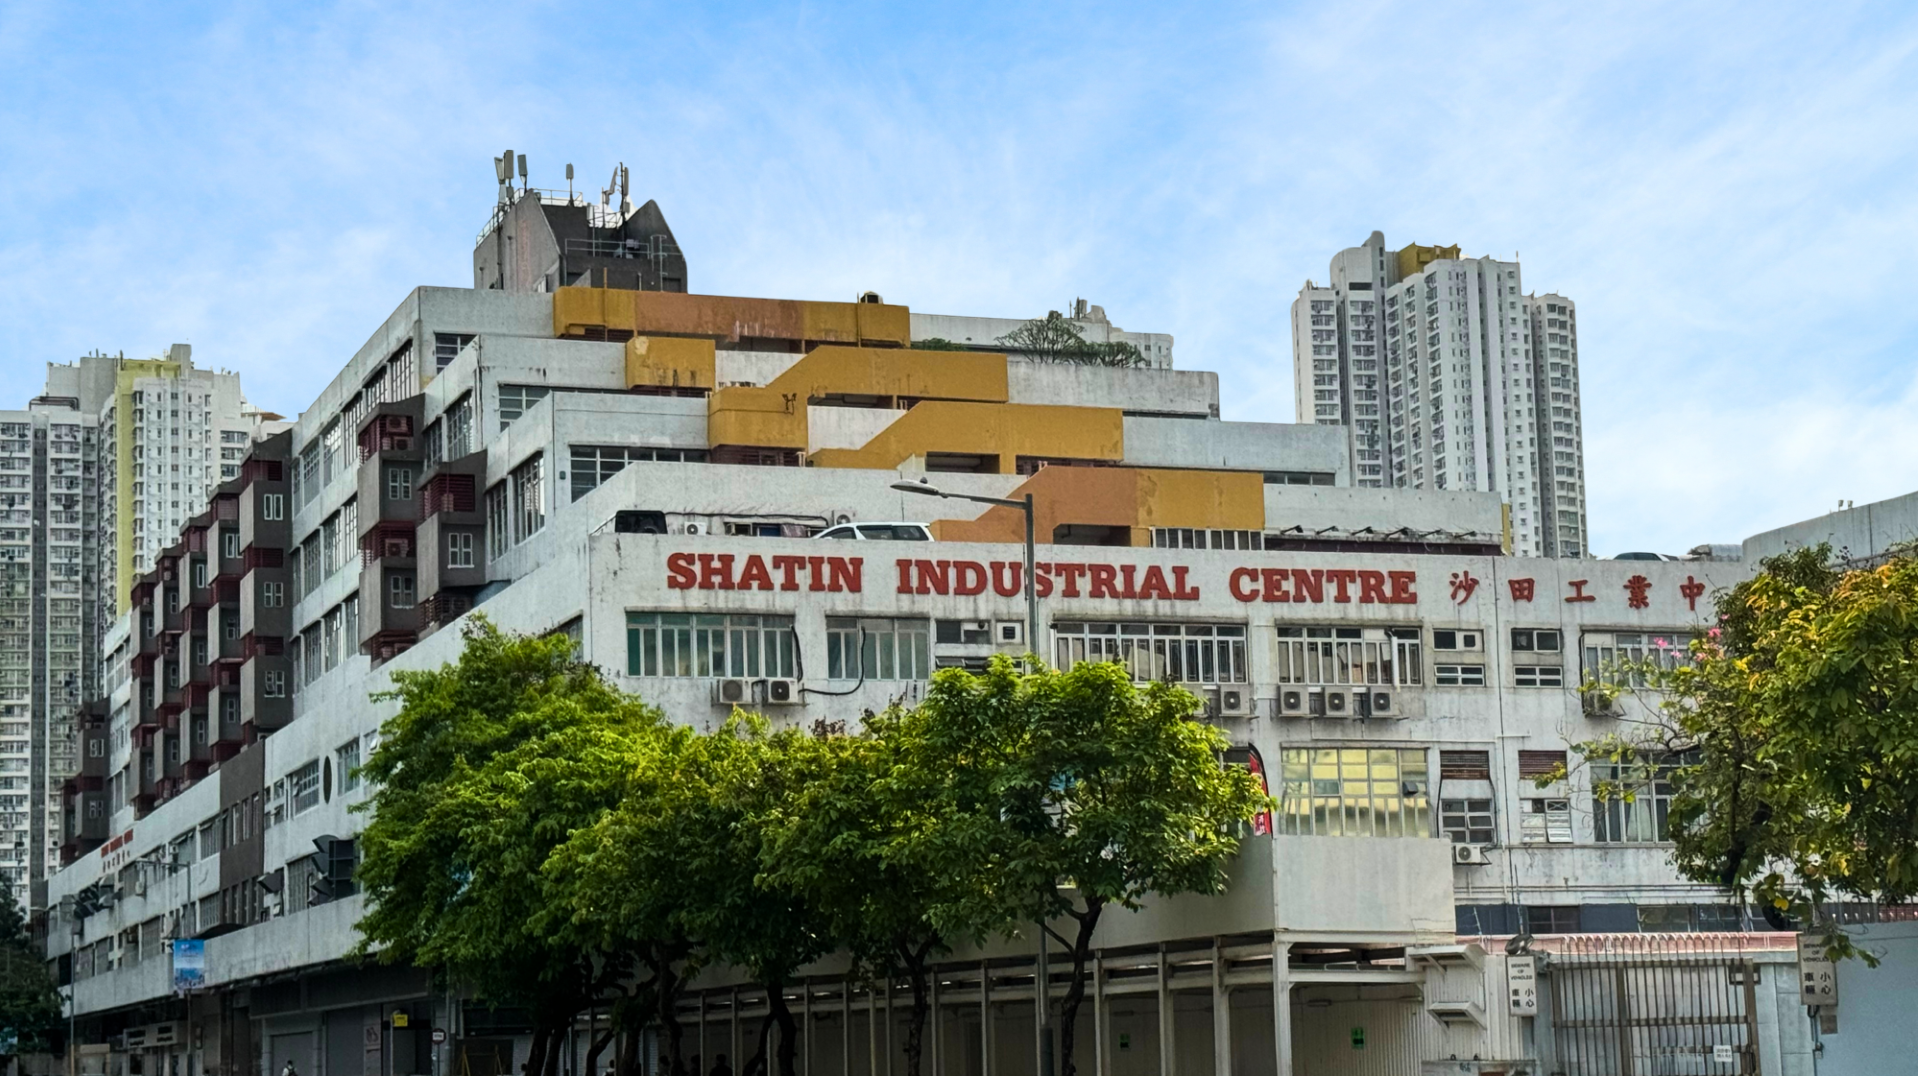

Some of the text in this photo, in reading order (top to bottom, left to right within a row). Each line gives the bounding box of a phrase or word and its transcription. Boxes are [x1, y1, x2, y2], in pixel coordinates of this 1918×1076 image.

[667, 552, 1417, 604] SHATIN INDUSTRIAL CENTRE
